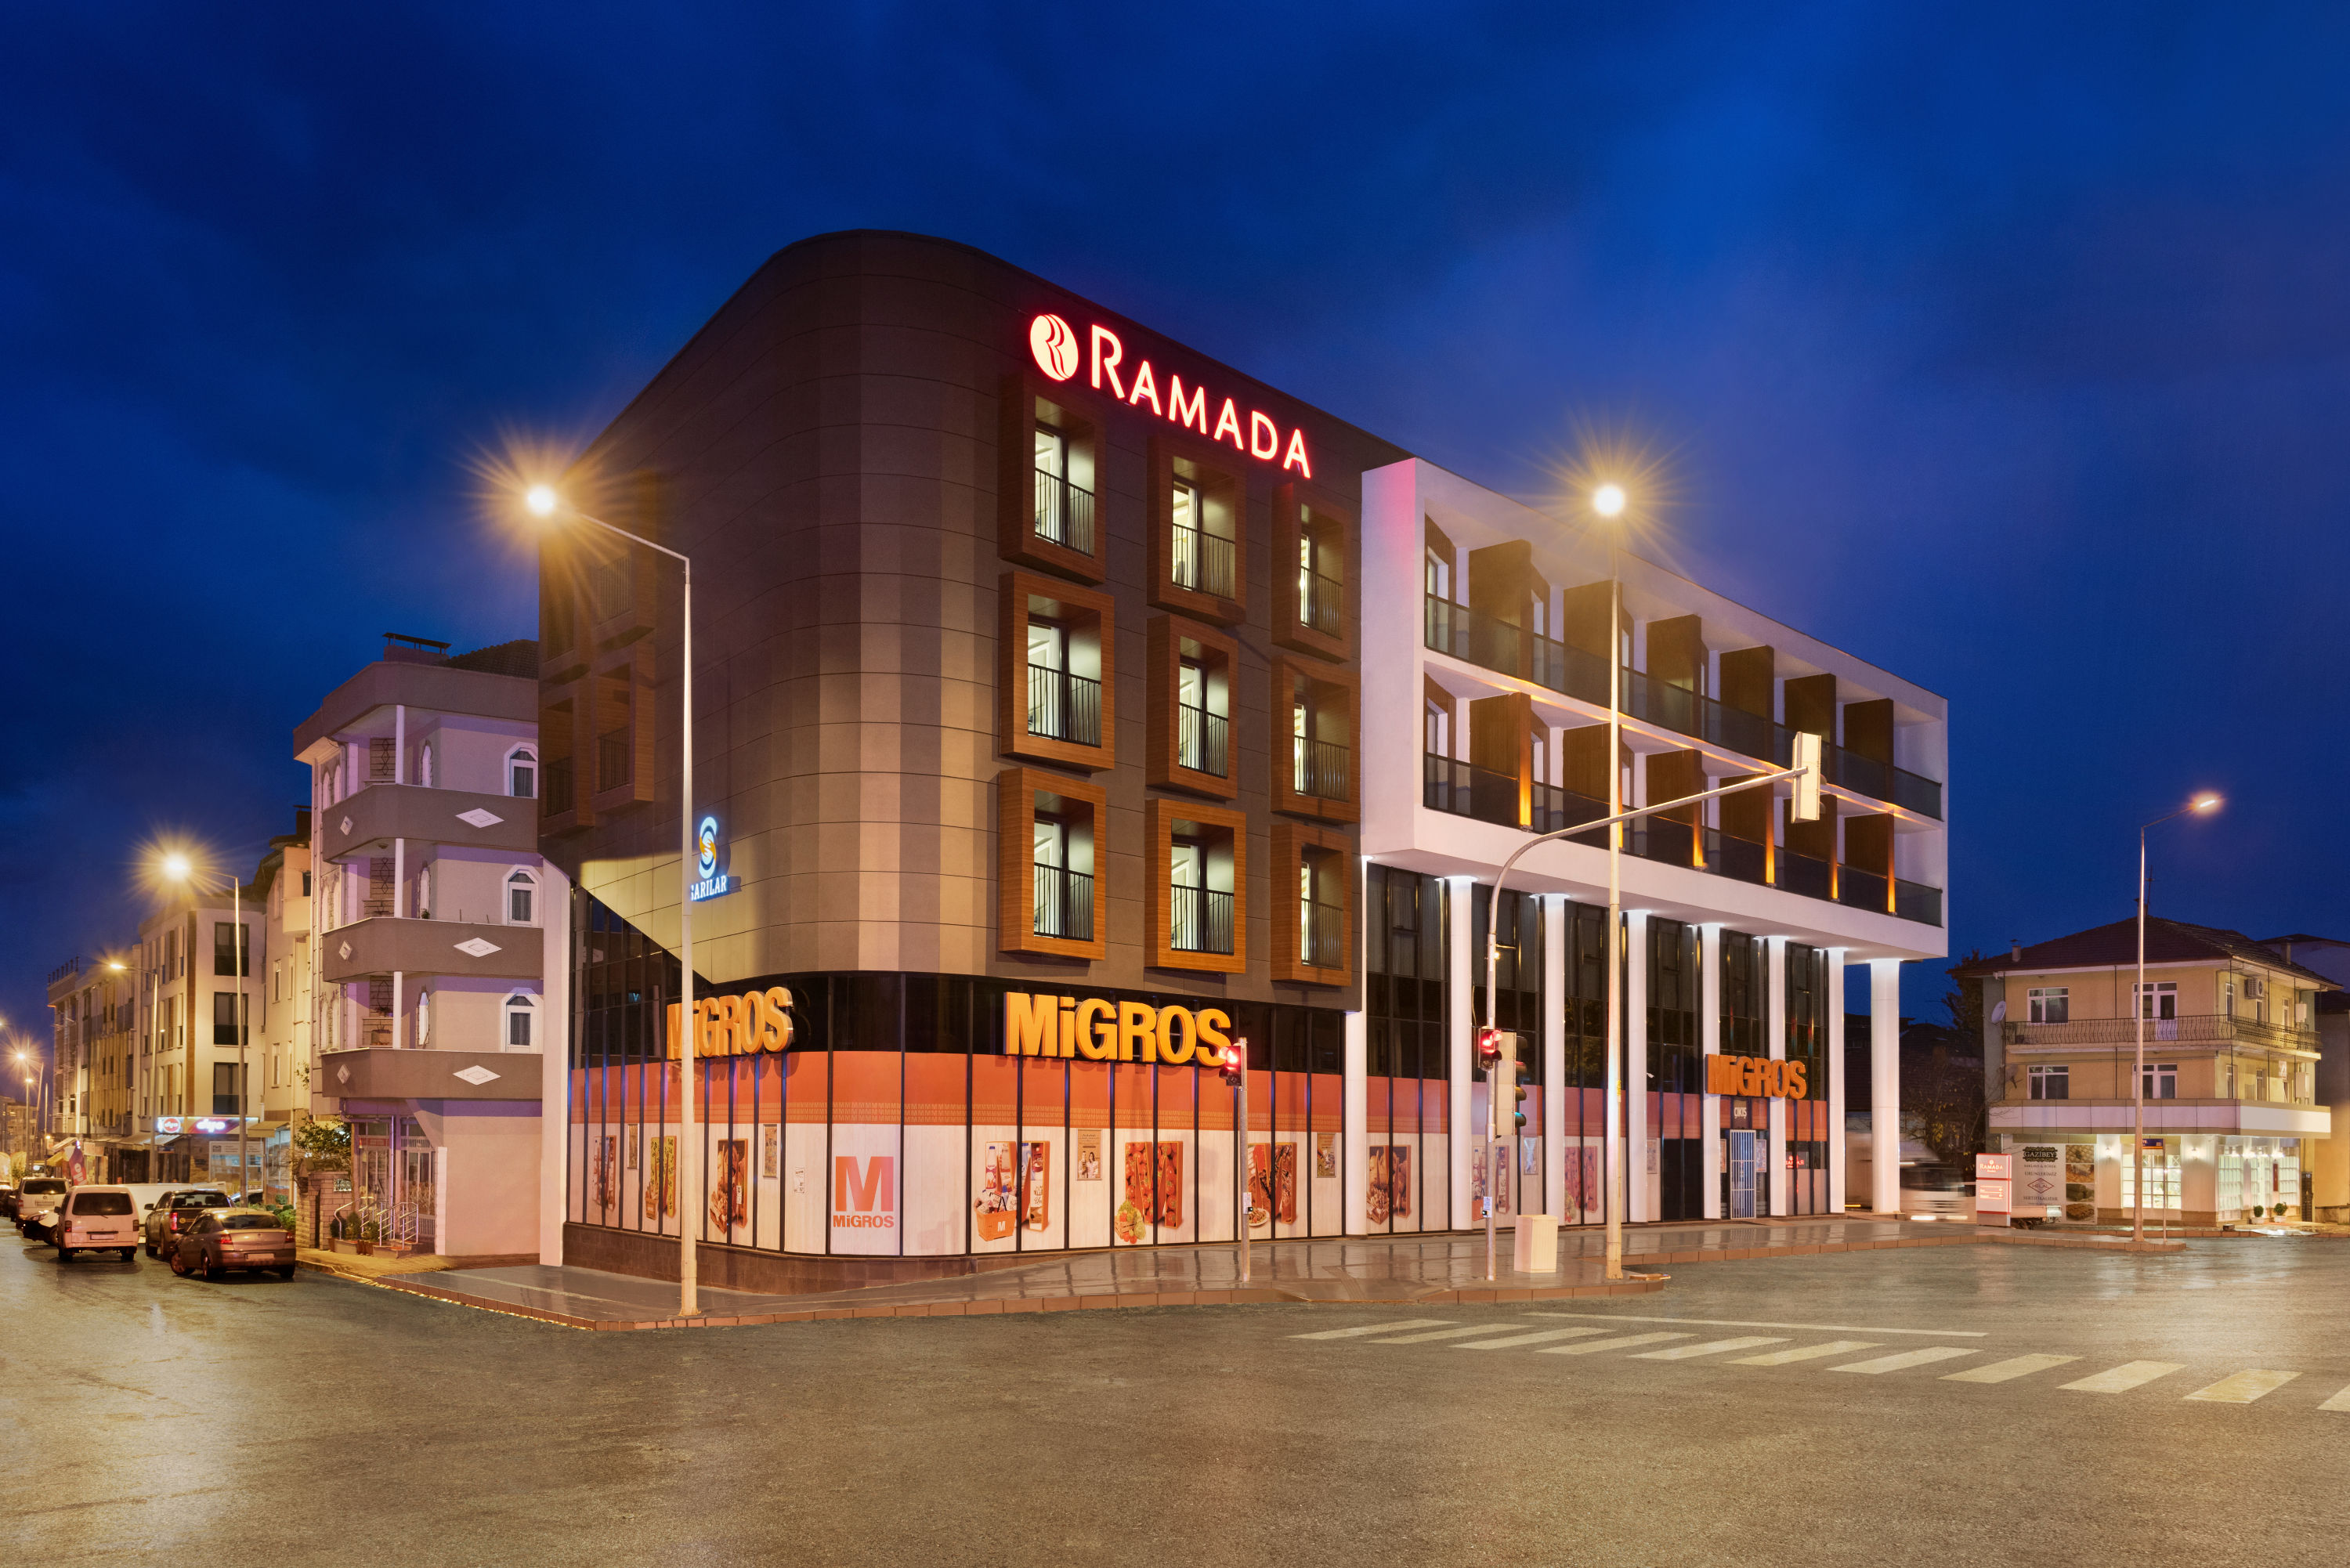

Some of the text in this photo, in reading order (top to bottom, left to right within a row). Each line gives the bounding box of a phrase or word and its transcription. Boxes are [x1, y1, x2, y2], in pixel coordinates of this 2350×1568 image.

[1091, 323, 1311, 479] RAMADA
[1734, 1106, 1748, 1119] ÇIKIŞ
[835, 1155, 894, 1212] M
[833, 1215, 895, 1228] MiGROS
